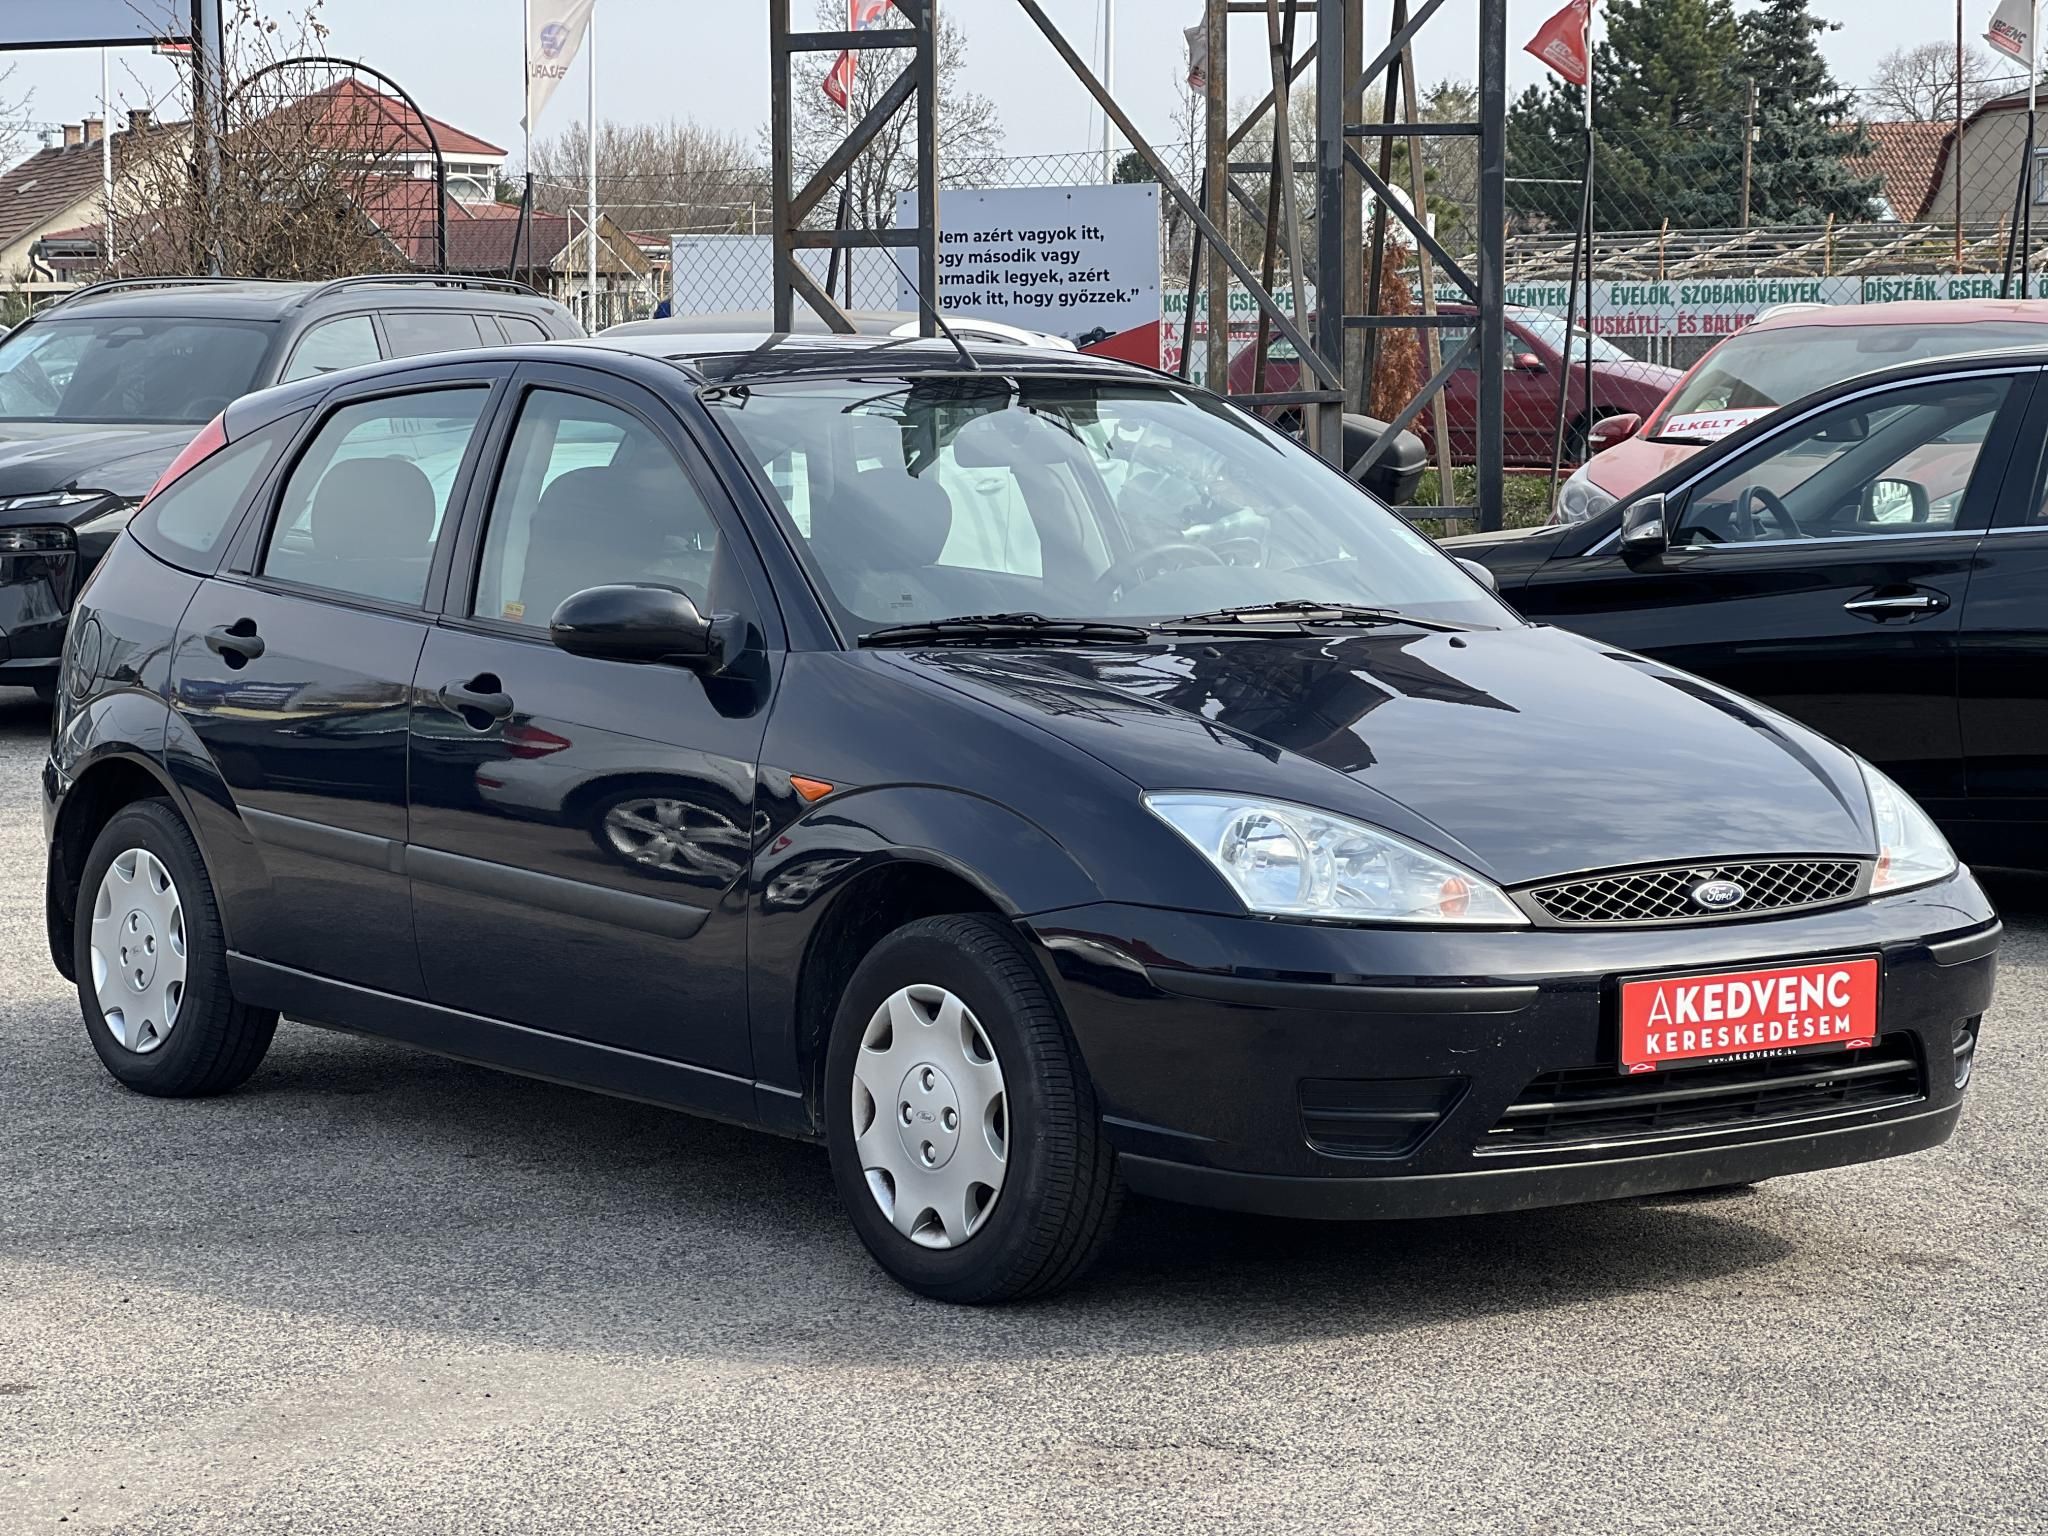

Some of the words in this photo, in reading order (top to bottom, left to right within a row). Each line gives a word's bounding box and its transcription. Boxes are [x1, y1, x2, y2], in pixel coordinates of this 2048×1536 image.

[973, 228, 1013, 243] azért
[1018, 226, 1077, 245] vagyok
[1081, 225, 1104, 243] itt,
[939, 252, 964, 267] ogy
[968, 248, 1037, 263] második
[1041, 250, 1080, 265] vagy
[939, 270, 1000, 285] armadik
[1005, 269, 1063, 287] legyek,
[1068, 268, 1110, 283] azért
[939, 291, 982, 308] gyok
[986, 290, 1008, 307] itt,
[1013, 291, 1054, 307] hogy
[1058, 289, 1139, 307] győzzek.”
[1611, 282, 1675, 306] ÉVELŐK,
[1681, 280, 1826, 305] SZOBANÖVÉNYEK,
[1677, 311, 1697, 334] ÉS
[1666, 418, 1735, 433] ELKELT
[1706, 886, 1734, 902] Ford
[1647, 971, 1851, 1027] AKEDVENC
[1646, 1013, 1850, 1054] KERESKEDÉSEM
